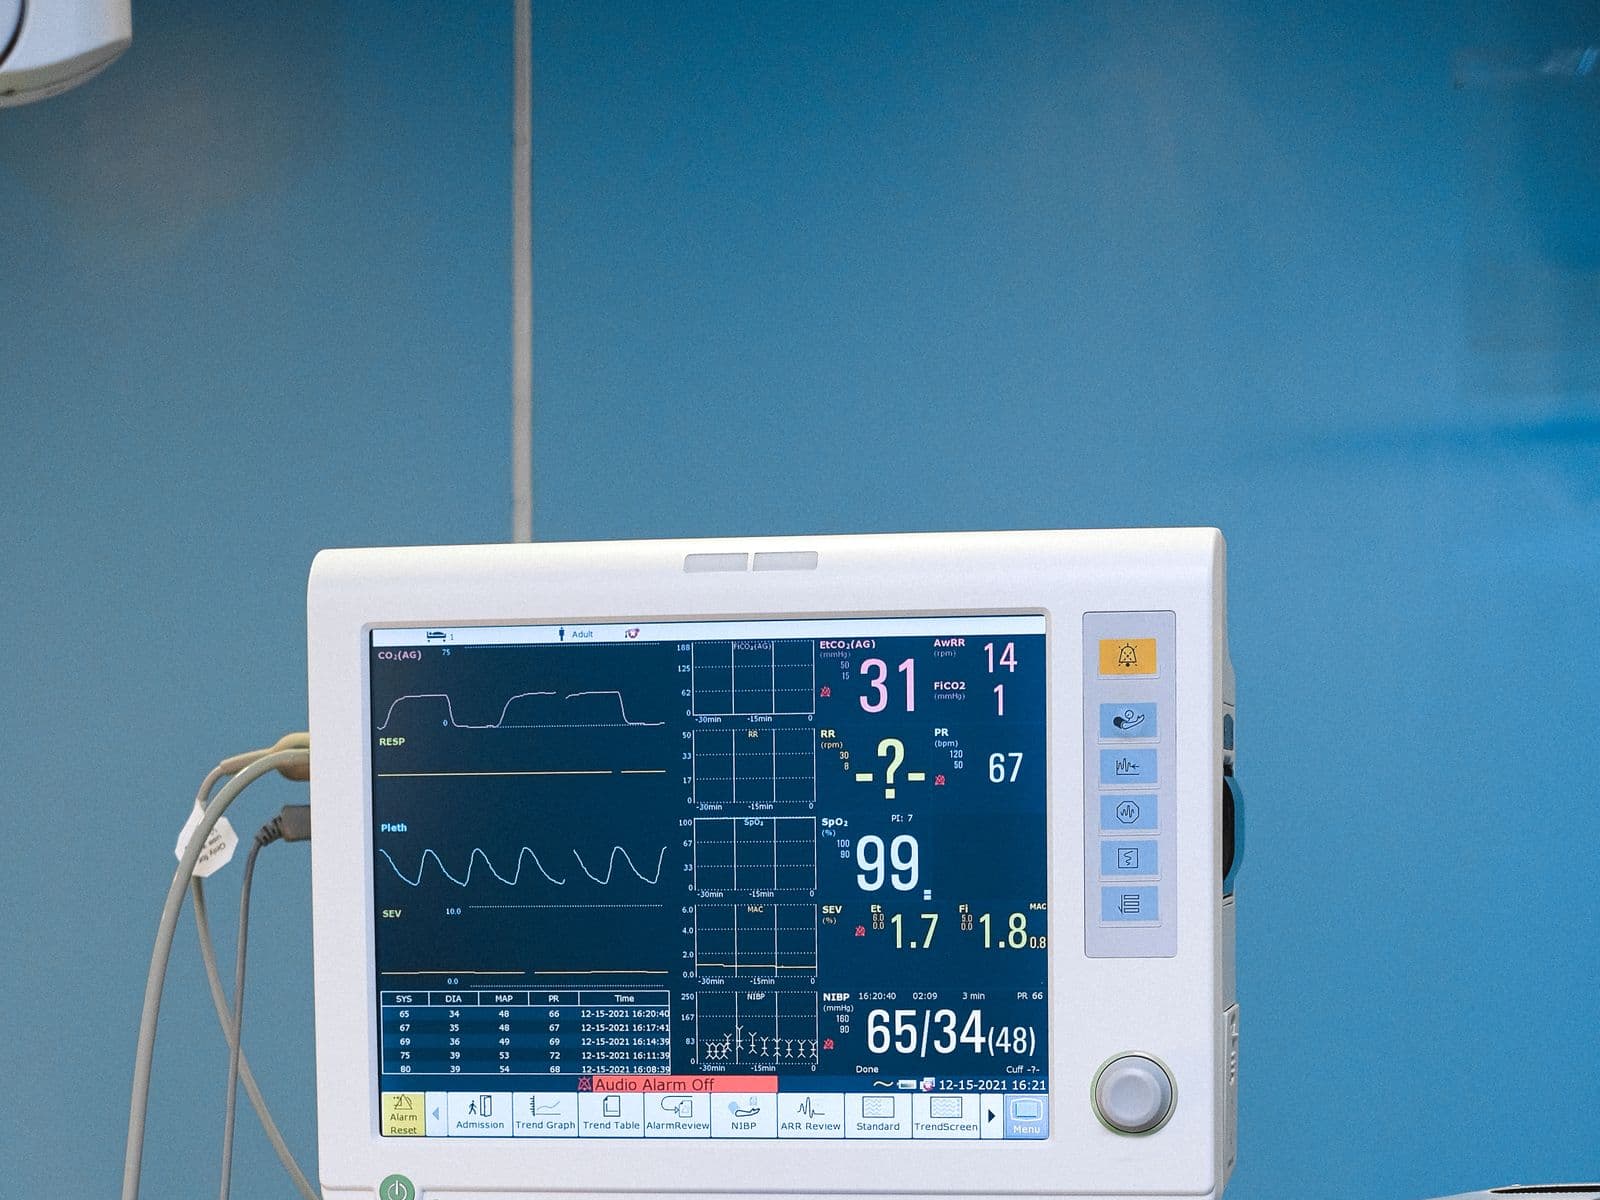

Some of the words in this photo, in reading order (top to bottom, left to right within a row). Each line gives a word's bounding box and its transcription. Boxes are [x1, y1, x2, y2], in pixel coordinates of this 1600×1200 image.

[572, 630, 593, 638] Adult
[933, 638, 966, 647] AwRR
[819, 651, 851, 659] (mmHg)
[984, 642, 1018, 673] 14
[840, 661, 850, 669] 50
[841, 672, 850, 680] 15
[859, 658, 915, 713] 31
[933, 681, 966, 690] FiCO2
[993, 684, 1004, 716] 1
[747, 715, 773, 723] -15min
[820, 729, 836, 738] RR
[934, 728, 949, 737] PR
[379, 737, 406, 746] RESP
[934, 740, 959, 748] (bpm)
[839, 751, 849, 760] 30
[949, 750, 963, 758] 120
[953, 761, 963, 769] 50
[989, 752, 1023, 783] 67
[696, 803, 723, 811] -30min
[907, 814, 913, 822] 7
[381, 823, 407, 832] Pleth
[821, 829, 836, 837] (%)
[837, 839, 850, 848] 100
[856, 834, 919, 891] 99
[682, 906, 694, 914] 6.0
[822, 905, 843, 914] SEV
[870, 904, 882, 913] Et
[959, 903, 969, 913] Fi
[382, 909, 402, 918] SEV
[822, 917, 837, 925] (%)
[891, 913, 939, 949] 1.7
[979, 912, 1028, 949] 1.8
[1029, 936, 1047, 949] 0.8
[447, 977, 459, 985] 0.0
[395, 995, 413, 1003] SYS
[445, 995, 462, 1003] DIA
[495, 995, 513, 1003] MAP
[548, 994, 560, 1003] PR
[614, 994, 635, 1003] Time
[823, 992, 850, 1002] NIBP
[858, 992, 897, 1000] 16:20:40
[912, 992, 938, 1000] 02:09
[962, 992, 968, 1000] 3
[970, 992, 985, 1000] min
[1017, 992, 1028, 1000] PR
[1032, 992, 1043, 1000] 66
[823, 1004, 854, 1012] (mmHg)
[399, 1010, 410, 1018] 65
[449, 1010, 460, 1018] 34
[499, 1010, 510, 1018] 48
[548, 1010, 560, 1018] 66
[581, 1010, 629, 1018] 12-15-2021
[632, 1010, 669, 1018] 16:20:40
[399, 1024, 410, 1032] 67
[449, 1024, 460, 1032] 35
[499, 1024, 510, 1032] 48
[549, 1024, 560, 1032] 67
[581, 1024, 629, 1032] 12-15-2021
[632, 1024, 669, 1032] 16:17:41
[399, 1038, 411, 1046] 69
[449, 1038, 460, 1046] 36
[499, 1038, 510, 1046] 49
[549, 1038, 560, 1046] 69
[582, 1038, 629, 1046] 12-15-2021
[633, 1038, 670, 1046] 16:14:39
[400, 1051, 410, 1060] 75
[450, 1051, 460, 1060] 39
[499, 1051, 510, 1060] 53
[549, 1051, 560, 1060] 72
[582, 1051, 629, 1060] 12-15-2021
[633, 1051, 670, 1060] 16:11:39
[400, 1065, 411, 1073] 80
[450, 1065, 460, 1073] 39
[499, 1065, 510, 1073] 54
[549, 1065, 560, 1073] 68
[582, 1065, 629, 1073] 12-15-2021
[633, 1065, 670, 1073] 16:08:39
[855, 1065, 879, 1074] Done
[1006, 1065, 1024, 1074] Cuff
[595, 1078, 637, 1091] Audio
[642, 1078, 686, 1091] Alarm
[692, 1078, 715, 1091] Off
[939, 1080, 1007, 1090] 12-15-2021
[1012, 1080, 1046, 1090] 16:21
[390, 1113, 418, 1121] Alarm
[456, 1121, 505, 1129] Admission
[516, 1121, 543, 1129] Trend
[546, 1121, 576, 1130] Graph
[583, 1121, 611, 1129] Trend
[614, 1121, 640, 1129] Table
[646, 1121, 710, 1130] AlarmReview
[731, 1122, 757, 1130] NIBP
[780, 1122, 802, 1130] ARR
[805, 1122, 841, 1130] Review
[856, 1122, 900, 1131] Standard
[914, 1122, 978, 1131] TrendScreen
[1013, 1125, 1041, 1134] Menu
[390, 1126, 417, 1134] Reset
